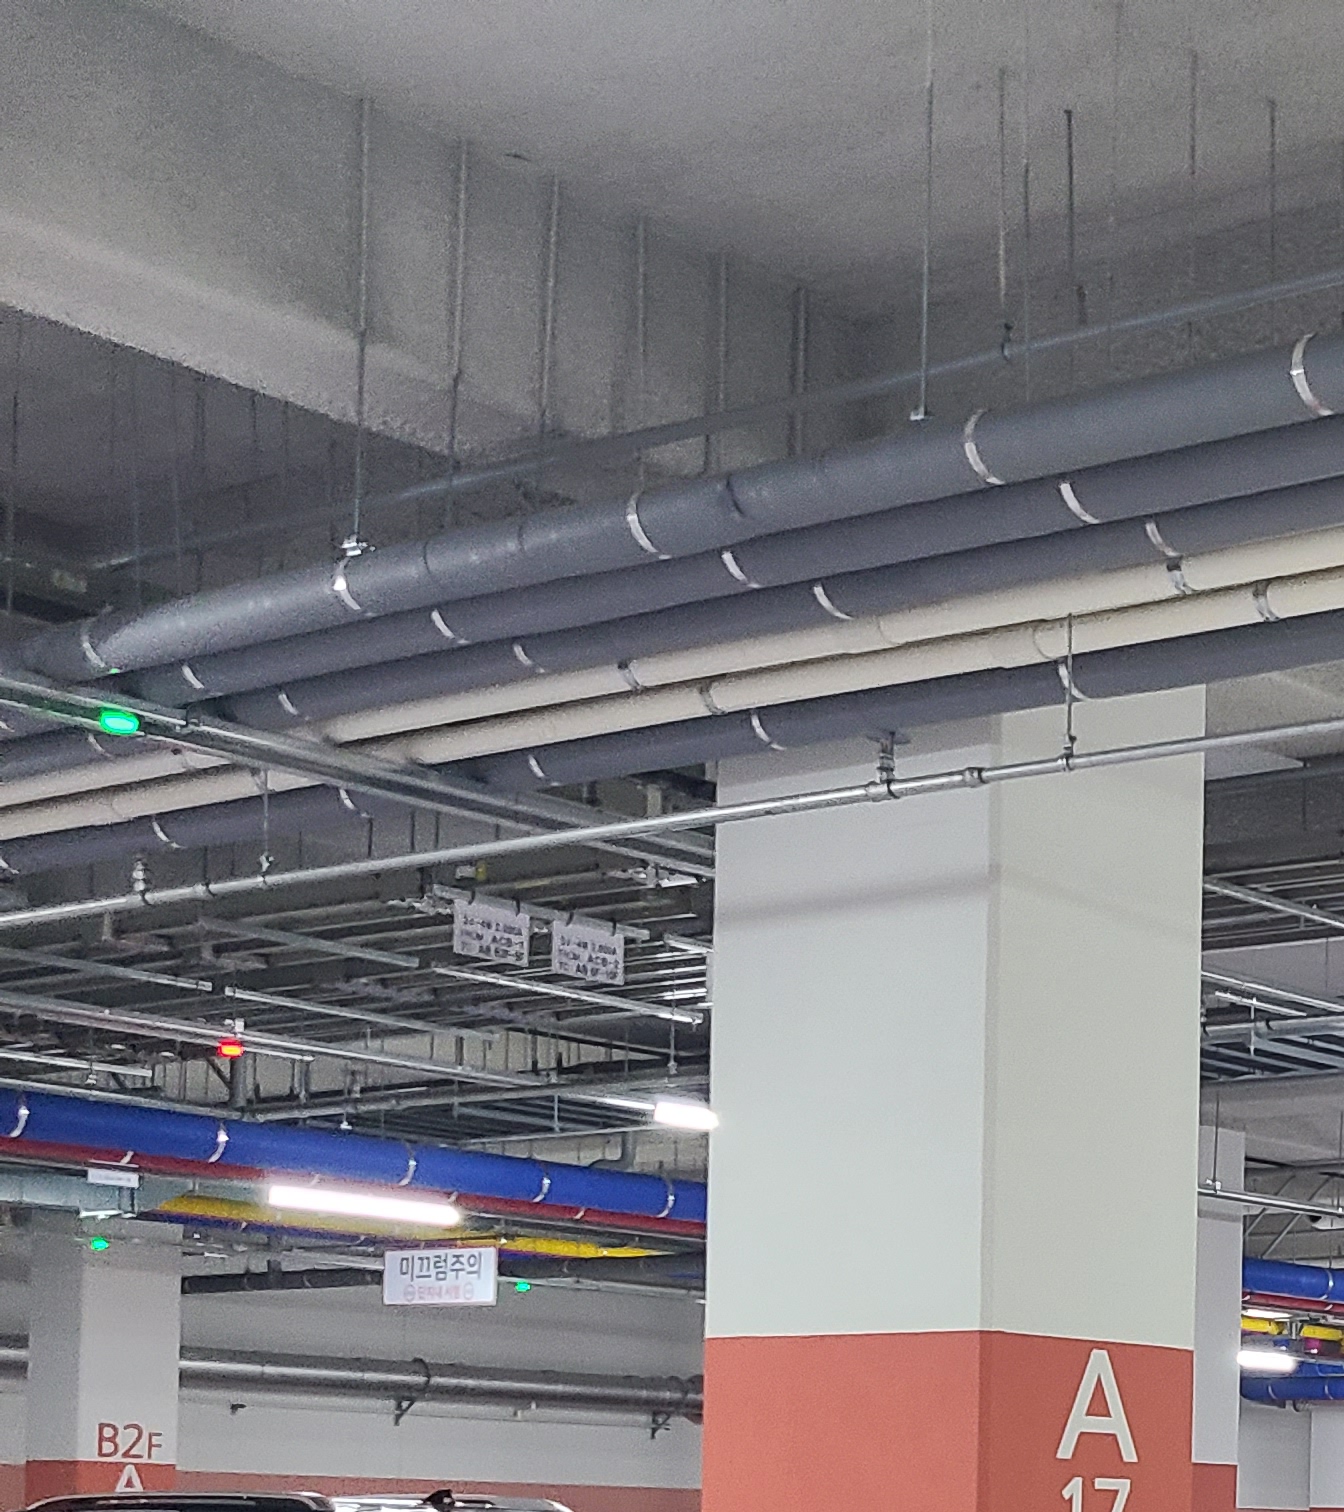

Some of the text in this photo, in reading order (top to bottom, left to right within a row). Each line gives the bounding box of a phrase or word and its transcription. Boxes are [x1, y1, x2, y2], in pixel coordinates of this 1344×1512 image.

[399, 1251, 483, 1282] 미끄럼주의
[1056, 1348, 1139, 1463] A
[97, 1422, 163, 1459] B2F
[114, 1463, 144, 1492] A
